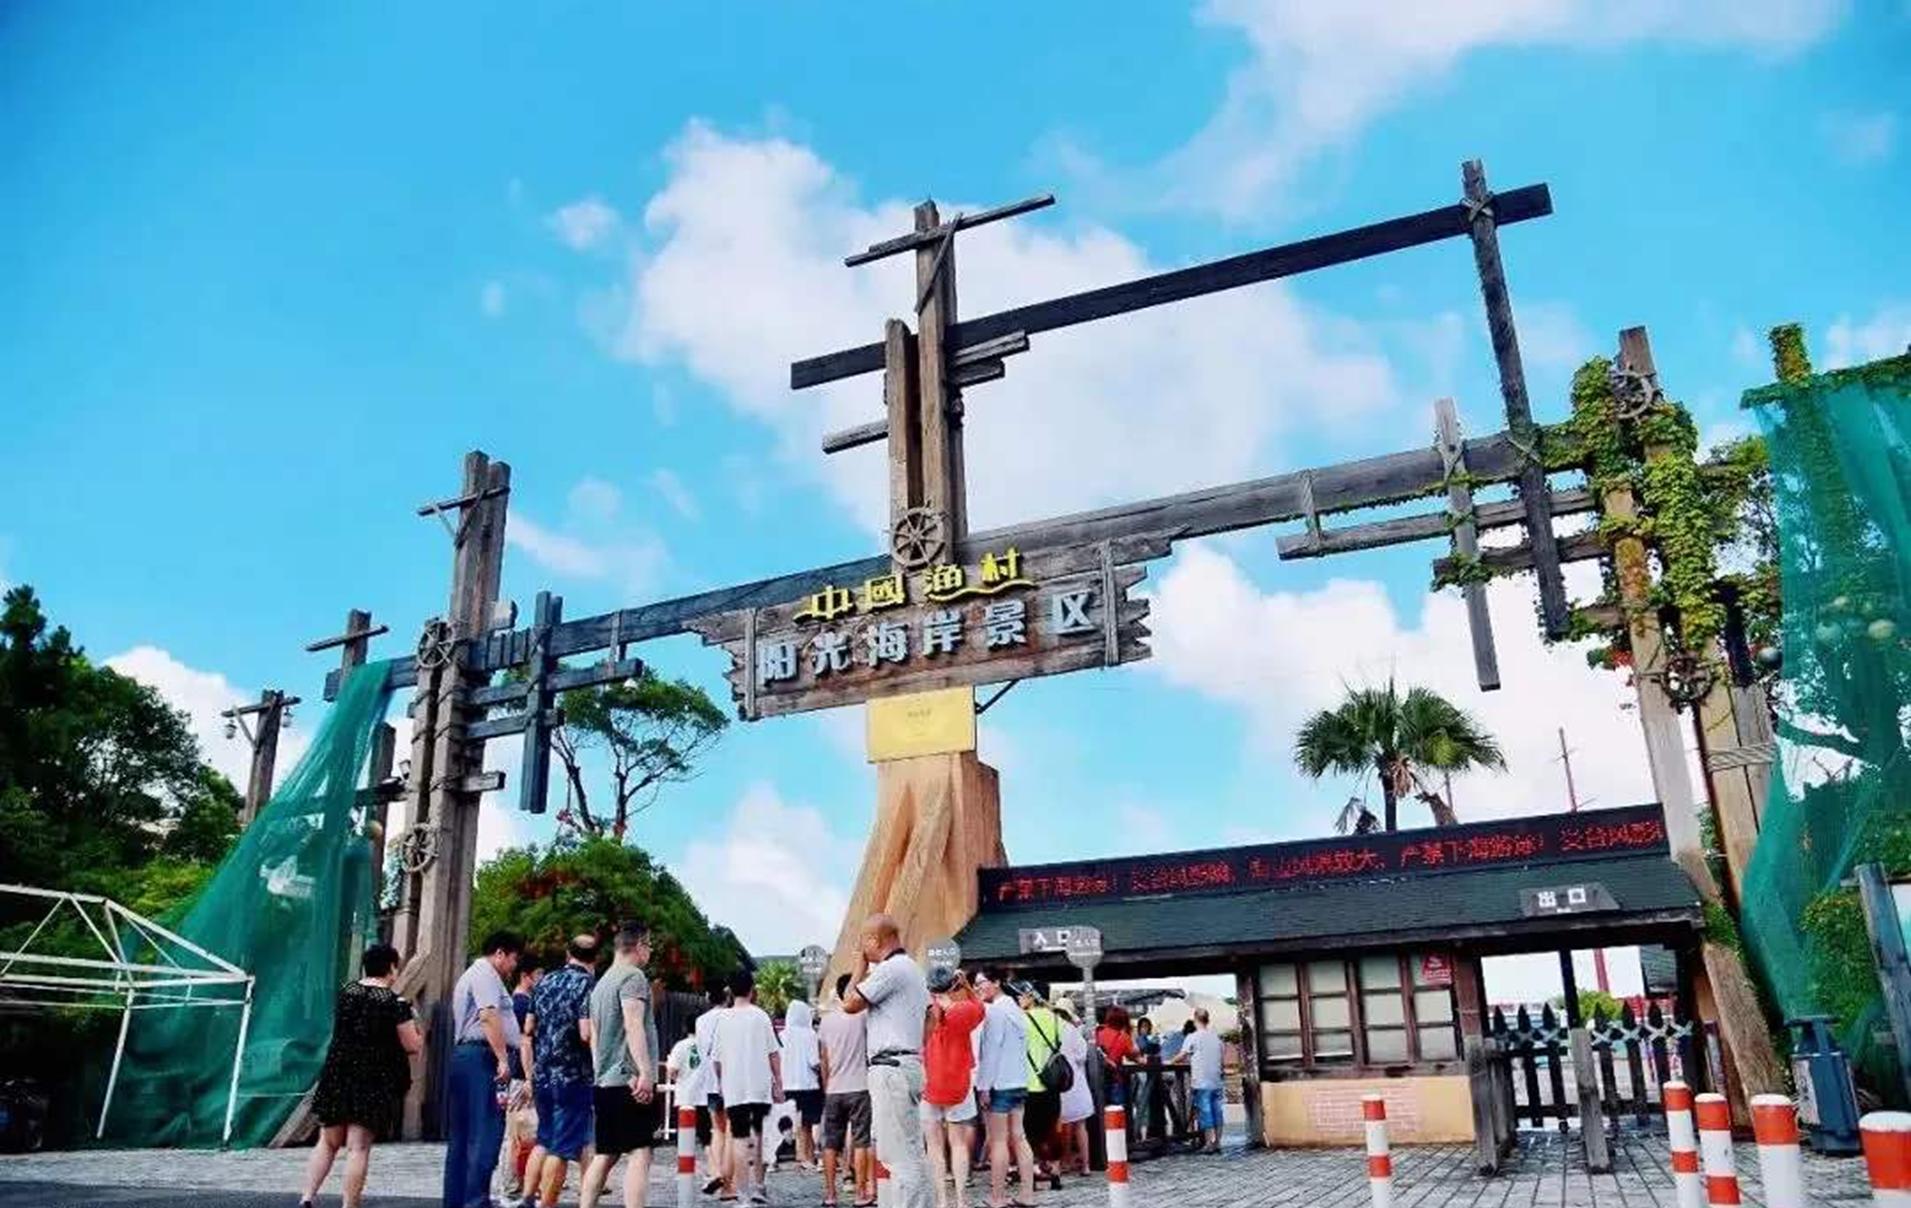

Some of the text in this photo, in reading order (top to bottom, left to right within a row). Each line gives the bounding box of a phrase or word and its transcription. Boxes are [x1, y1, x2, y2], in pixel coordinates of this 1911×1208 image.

[794, 546, 1020, 620] 中國渔村
[755, 588, 1094, 684] 阳光海岸景区
[1538, 887, 1586, 908] 出口
[1033, 929, 1071, 945] 入口
